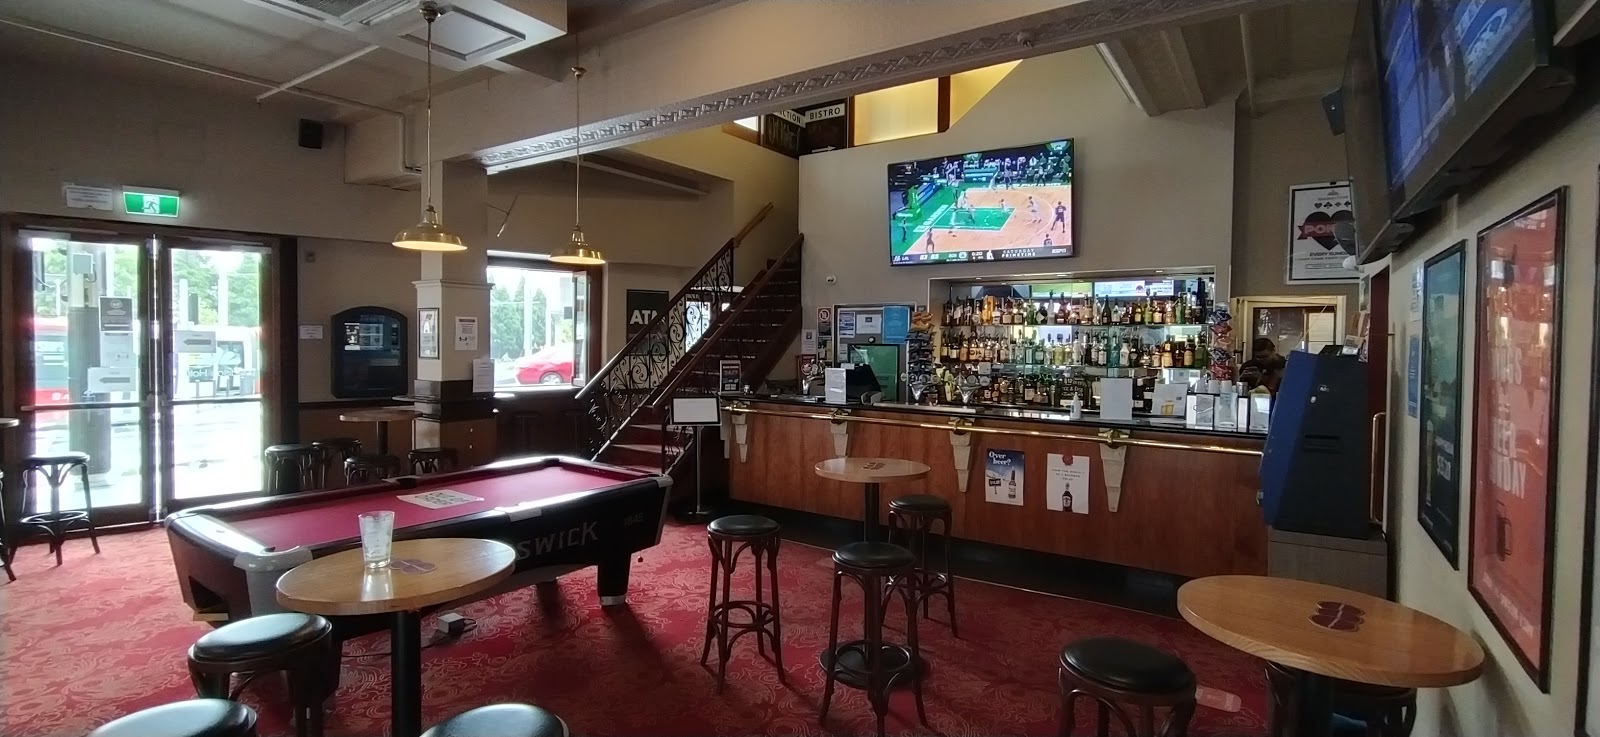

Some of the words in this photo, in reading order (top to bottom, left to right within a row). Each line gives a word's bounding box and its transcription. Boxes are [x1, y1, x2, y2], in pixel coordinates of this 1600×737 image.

[809, 107, 841, 120] BISTRO
[989, 451, 1006, 459] Over
[993, 457, 1011, 466] beer?
